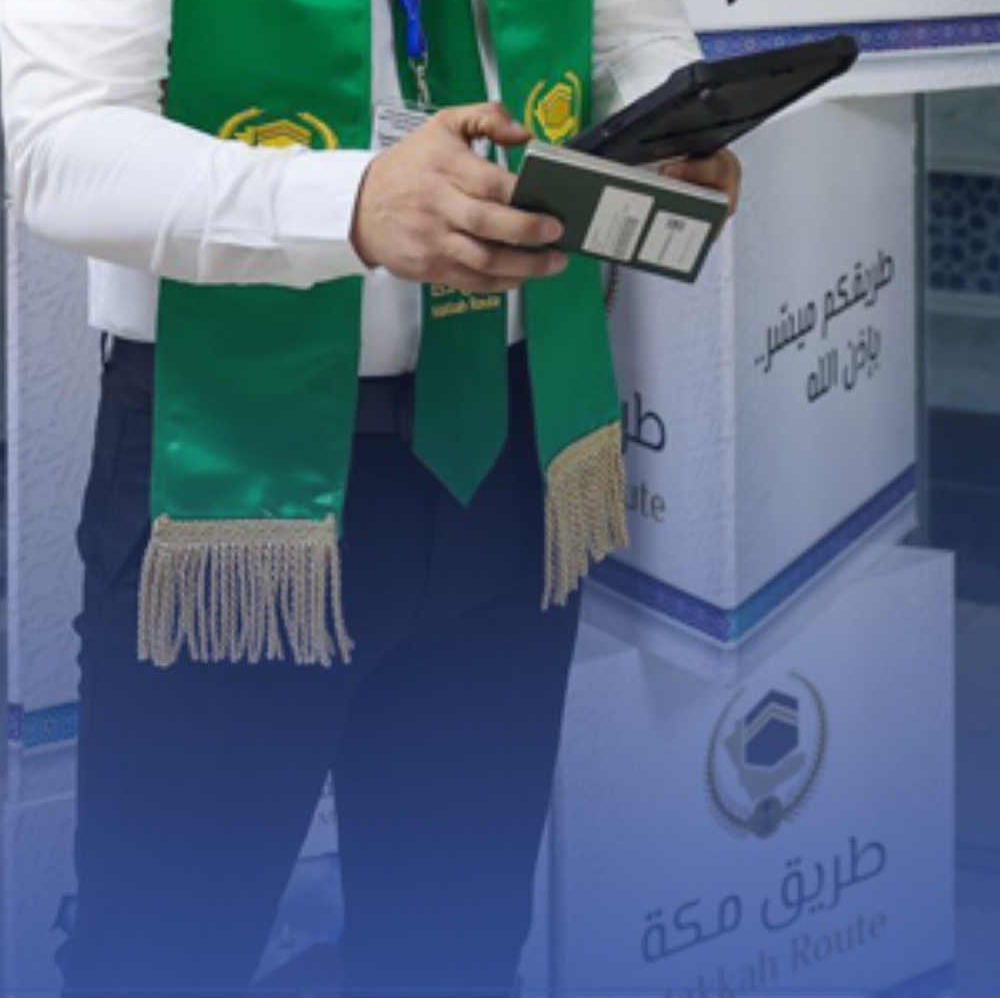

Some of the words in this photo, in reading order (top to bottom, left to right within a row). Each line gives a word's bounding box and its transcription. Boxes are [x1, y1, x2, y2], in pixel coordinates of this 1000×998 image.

[820, 249, 895, 341] طريقكم
[806, 348, 839, 403] الله
[760, 834, 888, 933] طريق
[640, 891, 743, 964] مكة
[789, 912, 888, 973] Route
